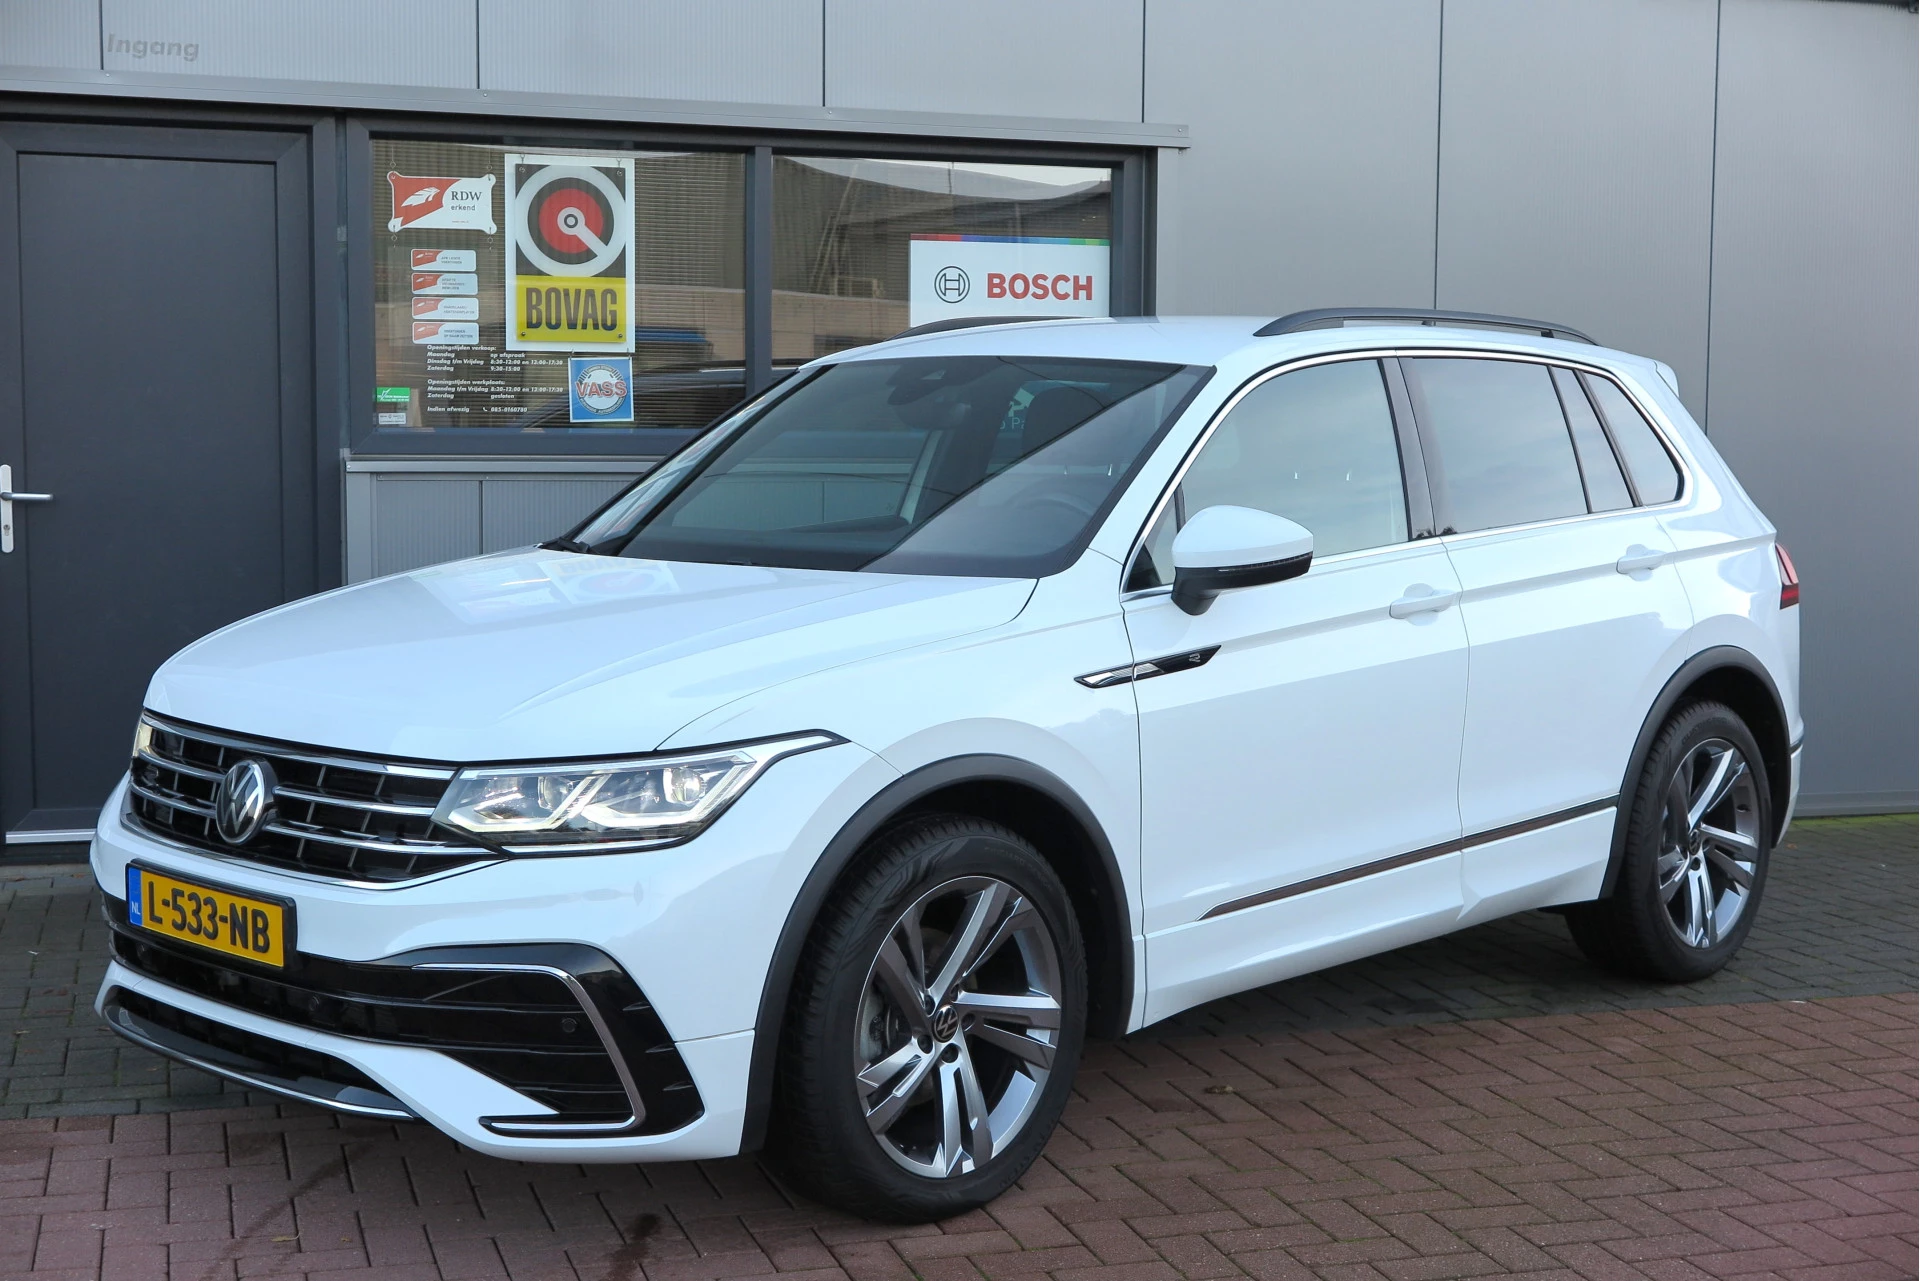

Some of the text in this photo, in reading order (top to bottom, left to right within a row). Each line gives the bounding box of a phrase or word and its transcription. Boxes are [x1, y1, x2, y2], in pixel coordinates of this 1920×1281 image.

[107, 33, 199, 62] Ingang
[451, 190, 482, 201] RDW
[987, 273, 1093, 301] BOSCH
[525, 287, 618, 331] BOVAG
[575, 380, 628, 398] VASS
[131, 901, 141, 915] NL
[148, 881, 270, 953] L-533-NB
